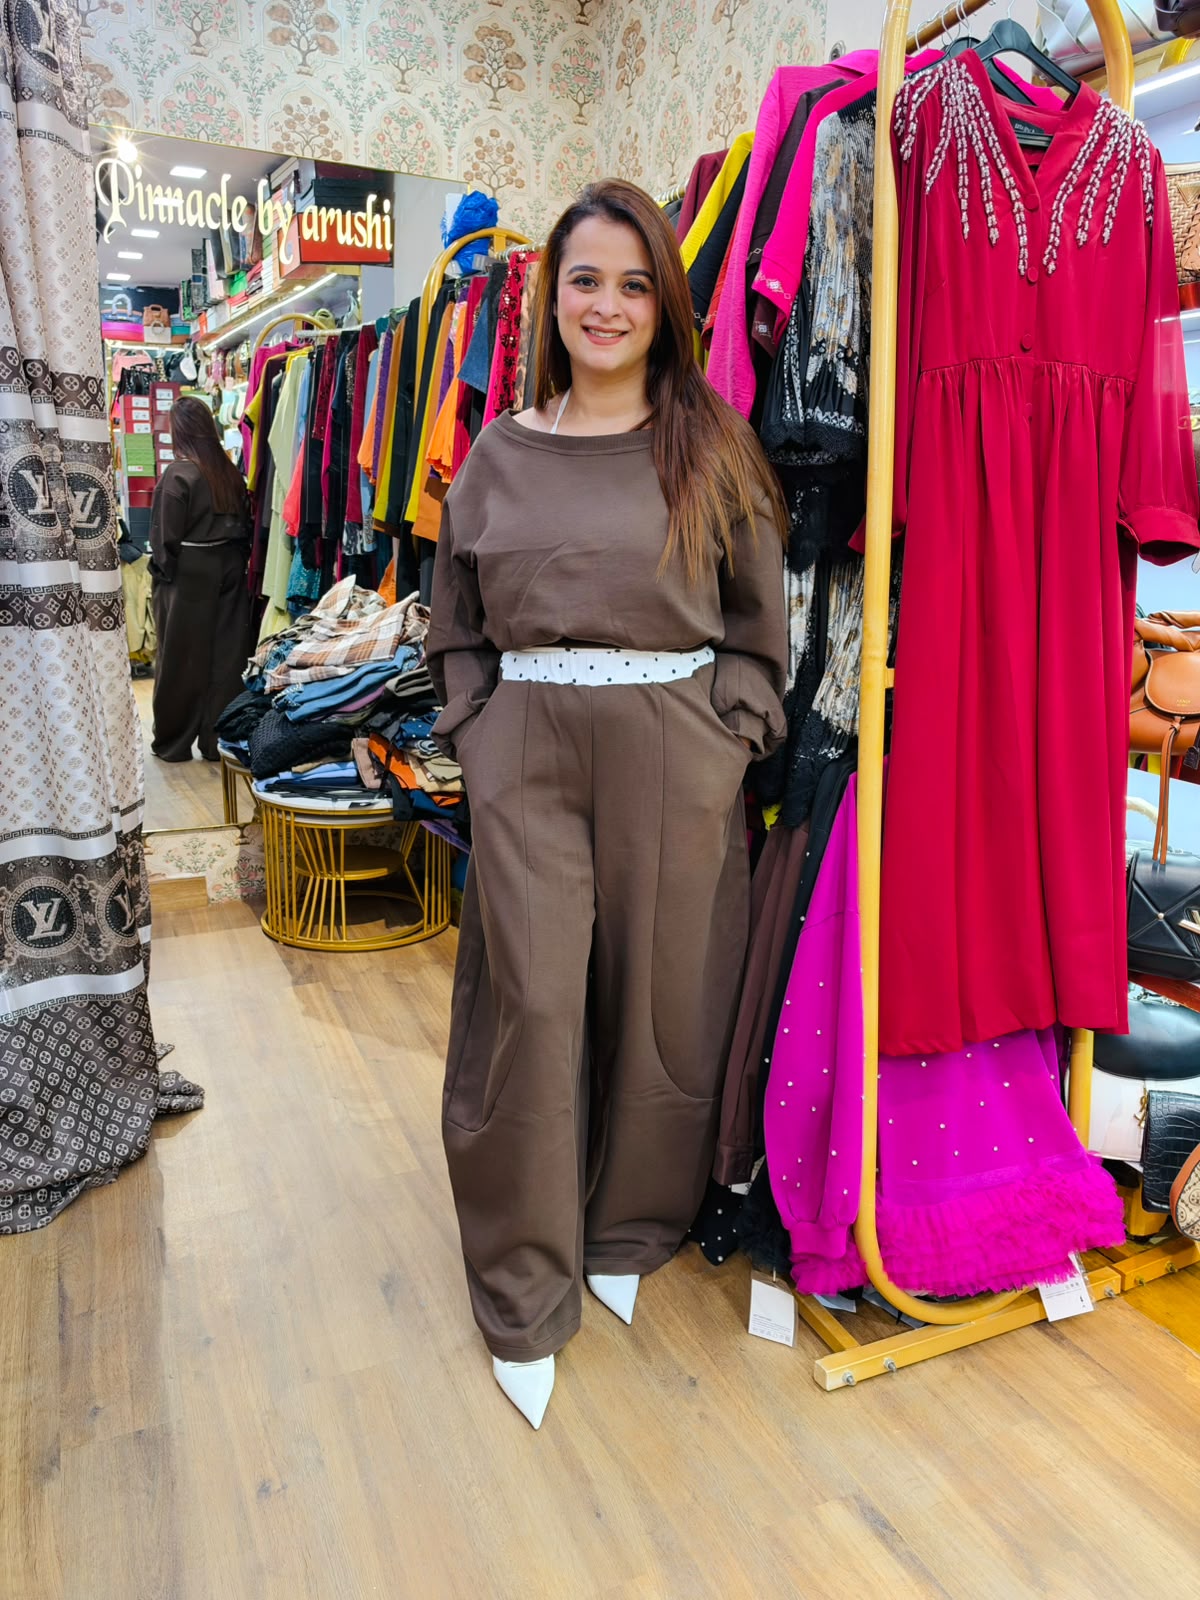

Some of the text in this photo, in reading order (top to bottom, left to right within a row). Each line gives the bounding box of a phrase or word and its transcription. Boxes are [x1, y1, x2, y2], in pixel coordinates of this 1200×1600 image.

[95, 157, 393, 265] Pinnacle by arushi
[20, 897, 68, 941] LV
